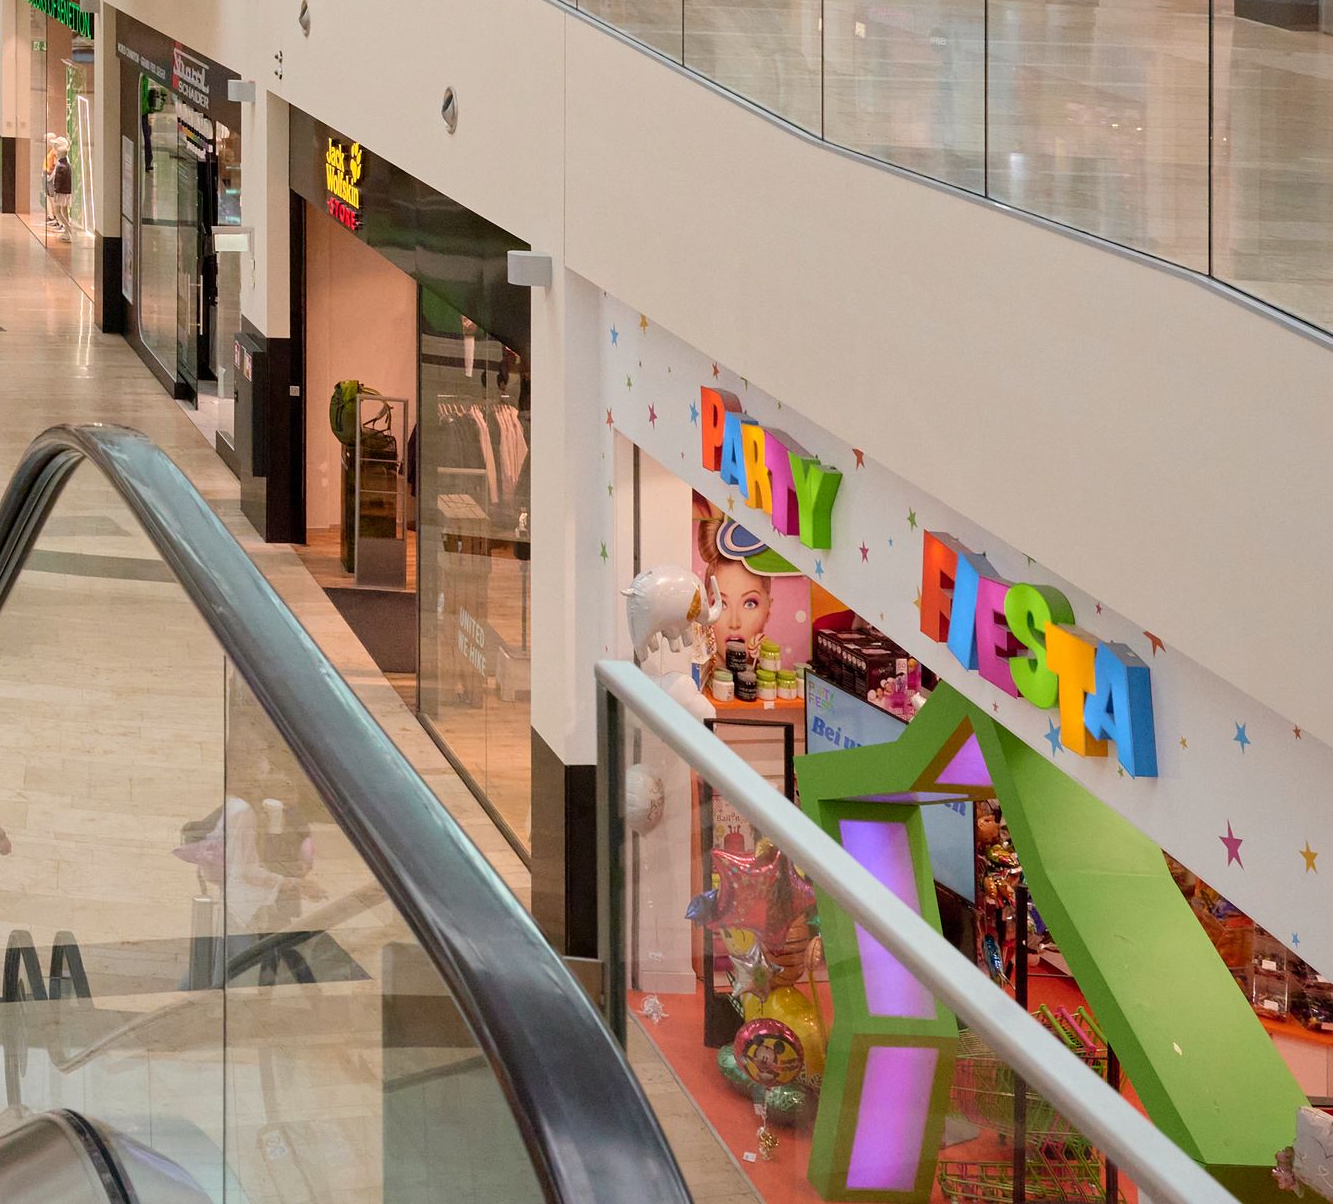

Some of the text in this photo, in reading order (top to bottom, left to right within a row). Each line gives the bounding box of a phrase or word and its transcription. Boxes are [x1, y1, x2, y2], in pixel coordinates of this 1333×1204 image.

[326, 138, 345, 172] Jack
[325, 162, 359, 209] Wolfskin
[700, 385, 842, 550] PARTY
[920, 530, 1159, 779] FIESTA
[812, 715, 841, 747] Bei
